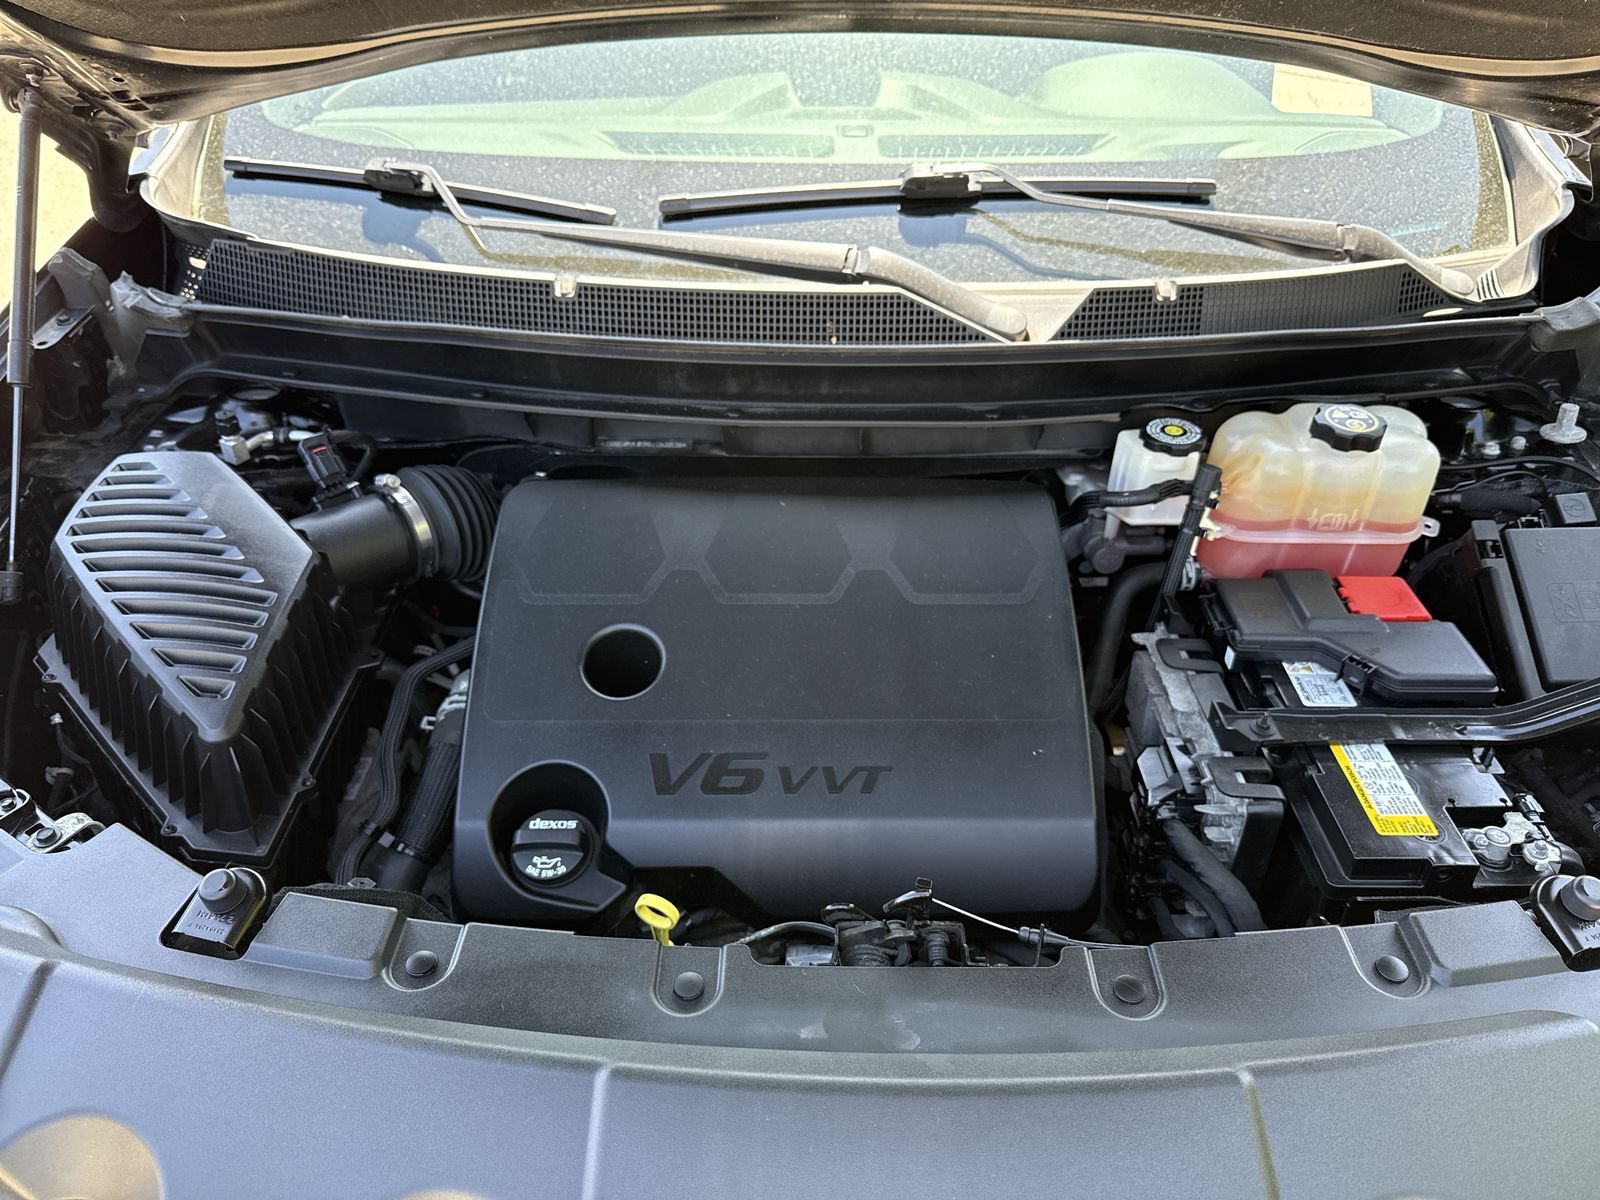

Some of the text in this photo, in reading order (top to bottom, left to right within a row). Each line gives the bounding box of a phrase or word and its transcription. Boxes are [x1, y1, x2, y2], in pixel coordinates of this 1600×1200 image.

[649, 752, 894, 796] V6 VVT
[528, 817, 579, 829] dexos
[525, 864, 567, 878] SAE 5W-30
